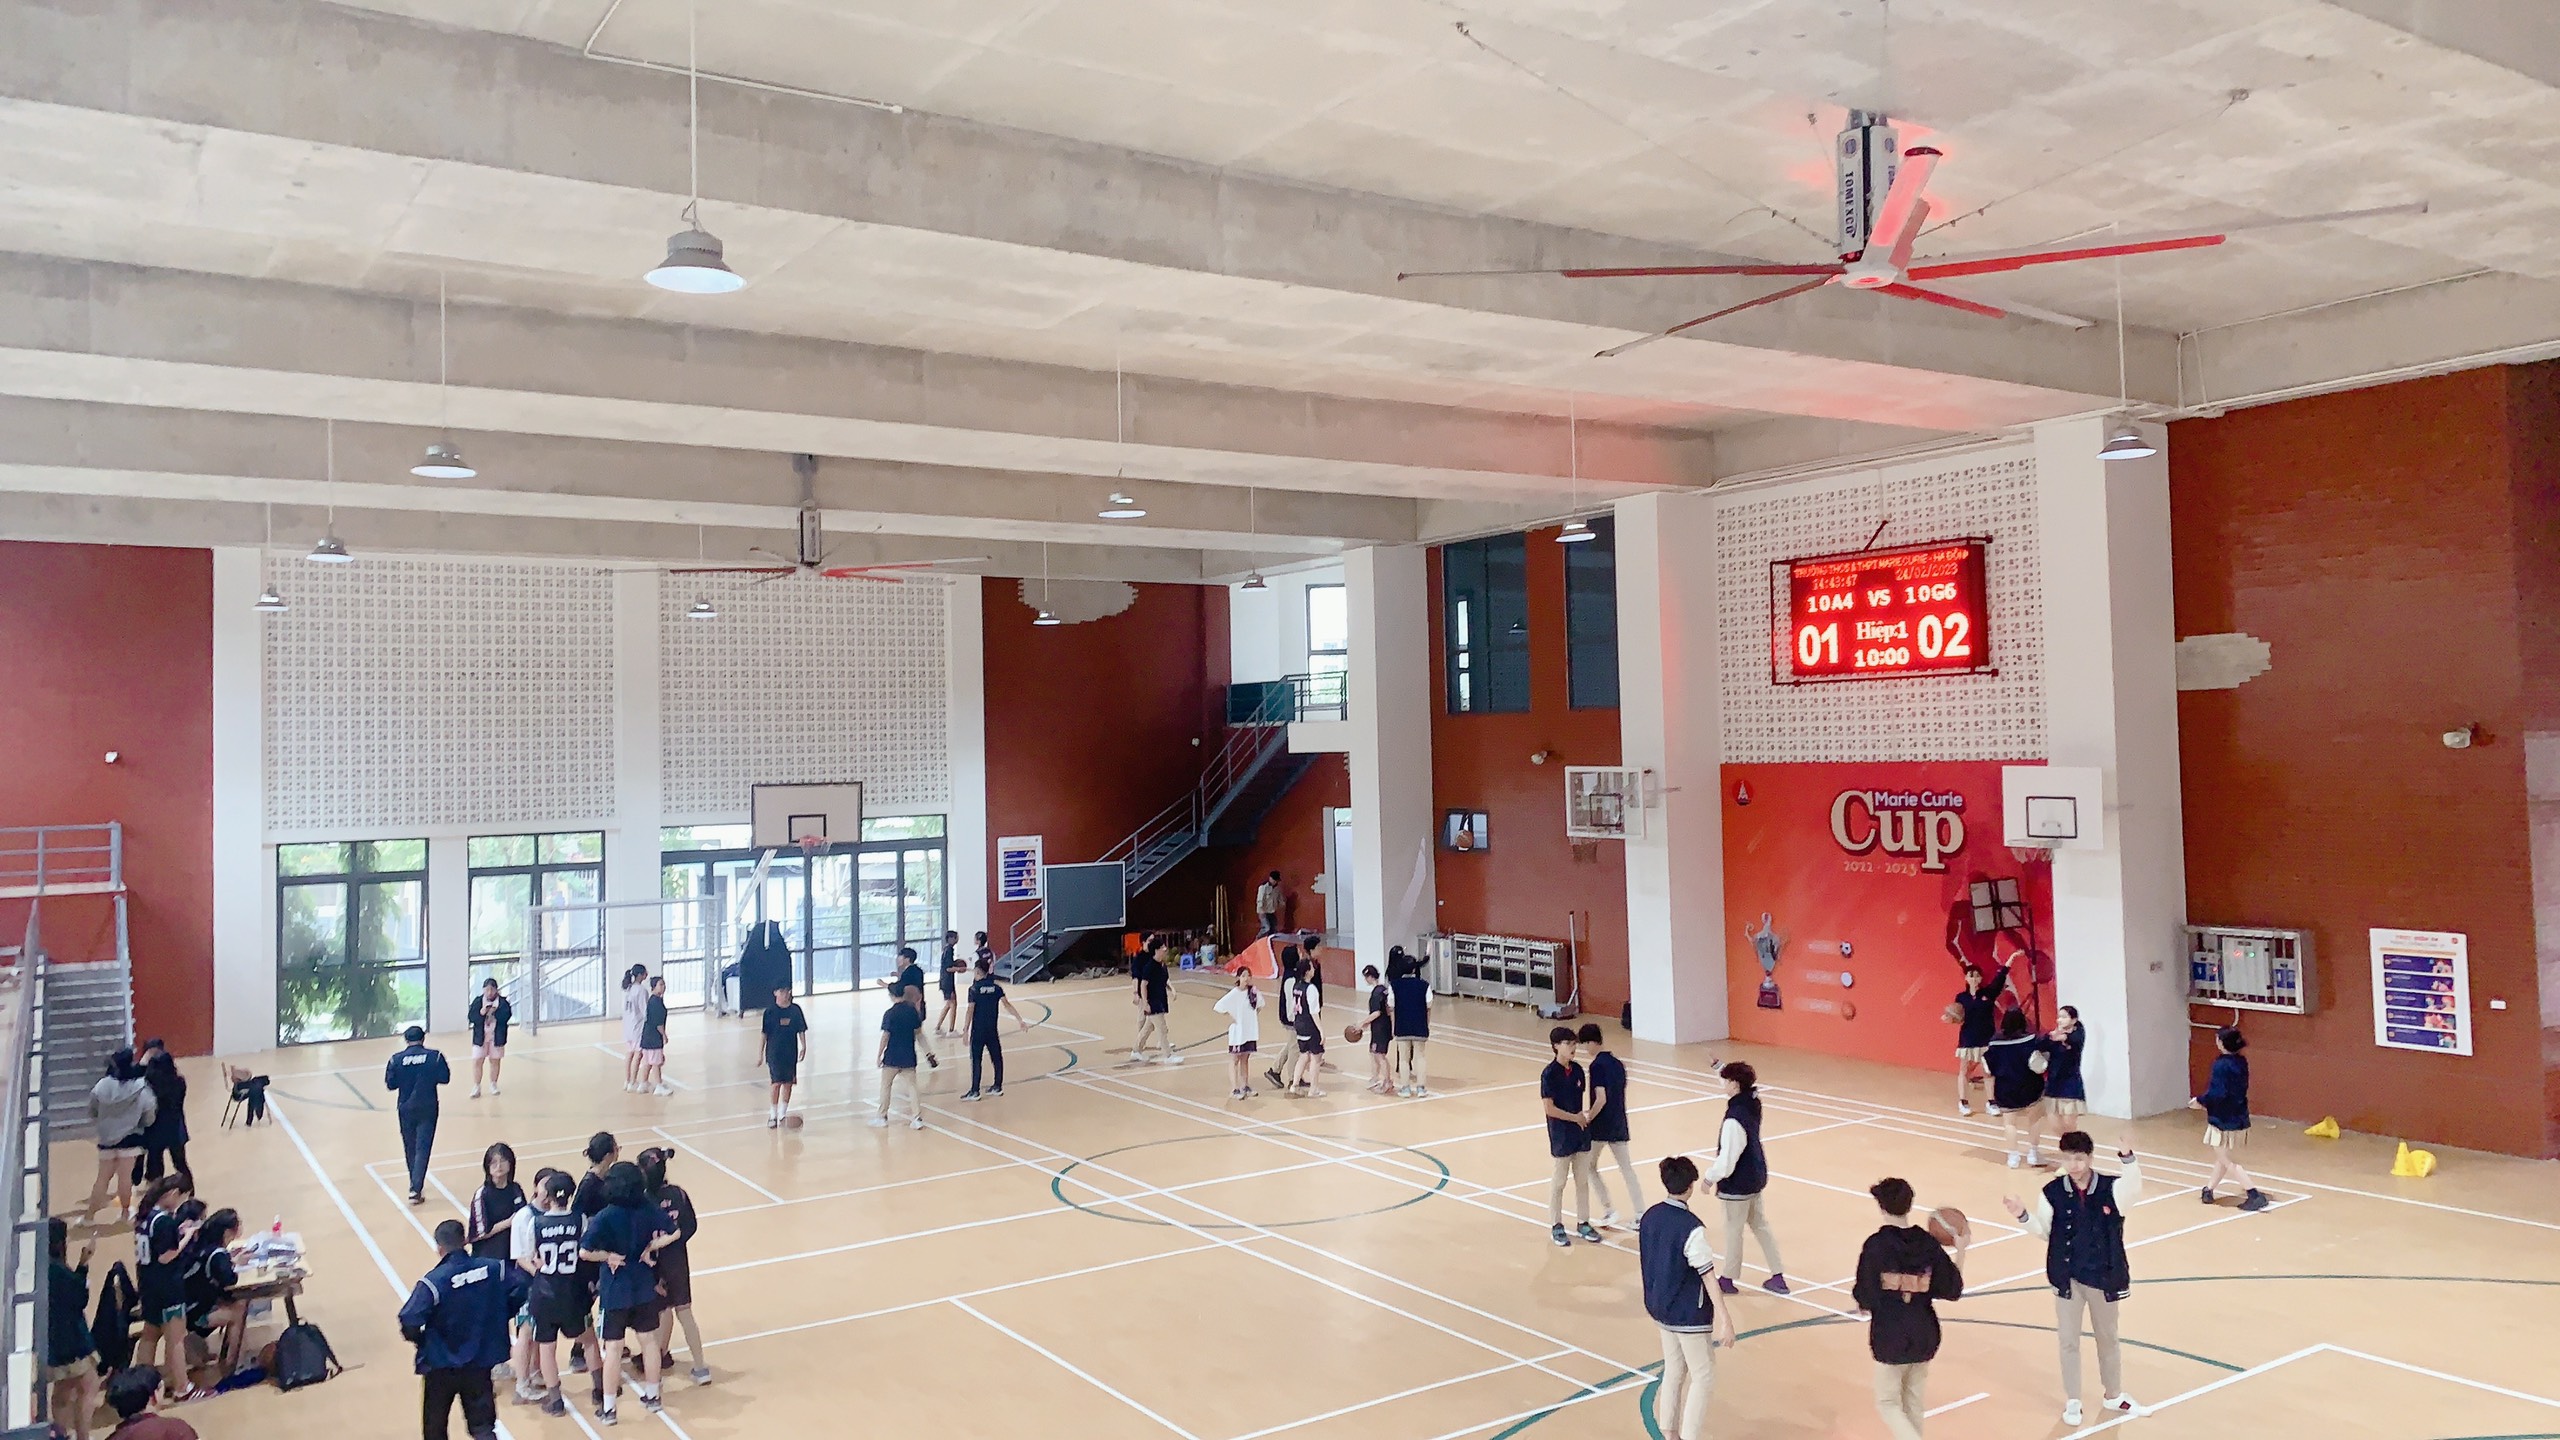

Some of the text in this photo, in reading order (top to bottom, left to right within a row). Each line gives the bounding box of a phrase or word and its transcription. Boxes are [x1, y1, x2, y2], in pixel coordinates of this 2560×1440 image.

[1895, 562, 1959, 581] 24/02/2023
[1807, 582, 1957, 613] 10A4 VS 10G6
[1798, 622, 1840, 666] 01
[1917, 612, 1971, 659] 02
[1854, 647, 1910, 667] 10:00
[1874, 791, 1963, 808] Marie Curie
[1830, 790, 1964, 869] Cup
[1843, 861, 1874, 873] 2022
[1884, 862, 1918, 877] 2023
[538, 1240, 579, 1275] 03
